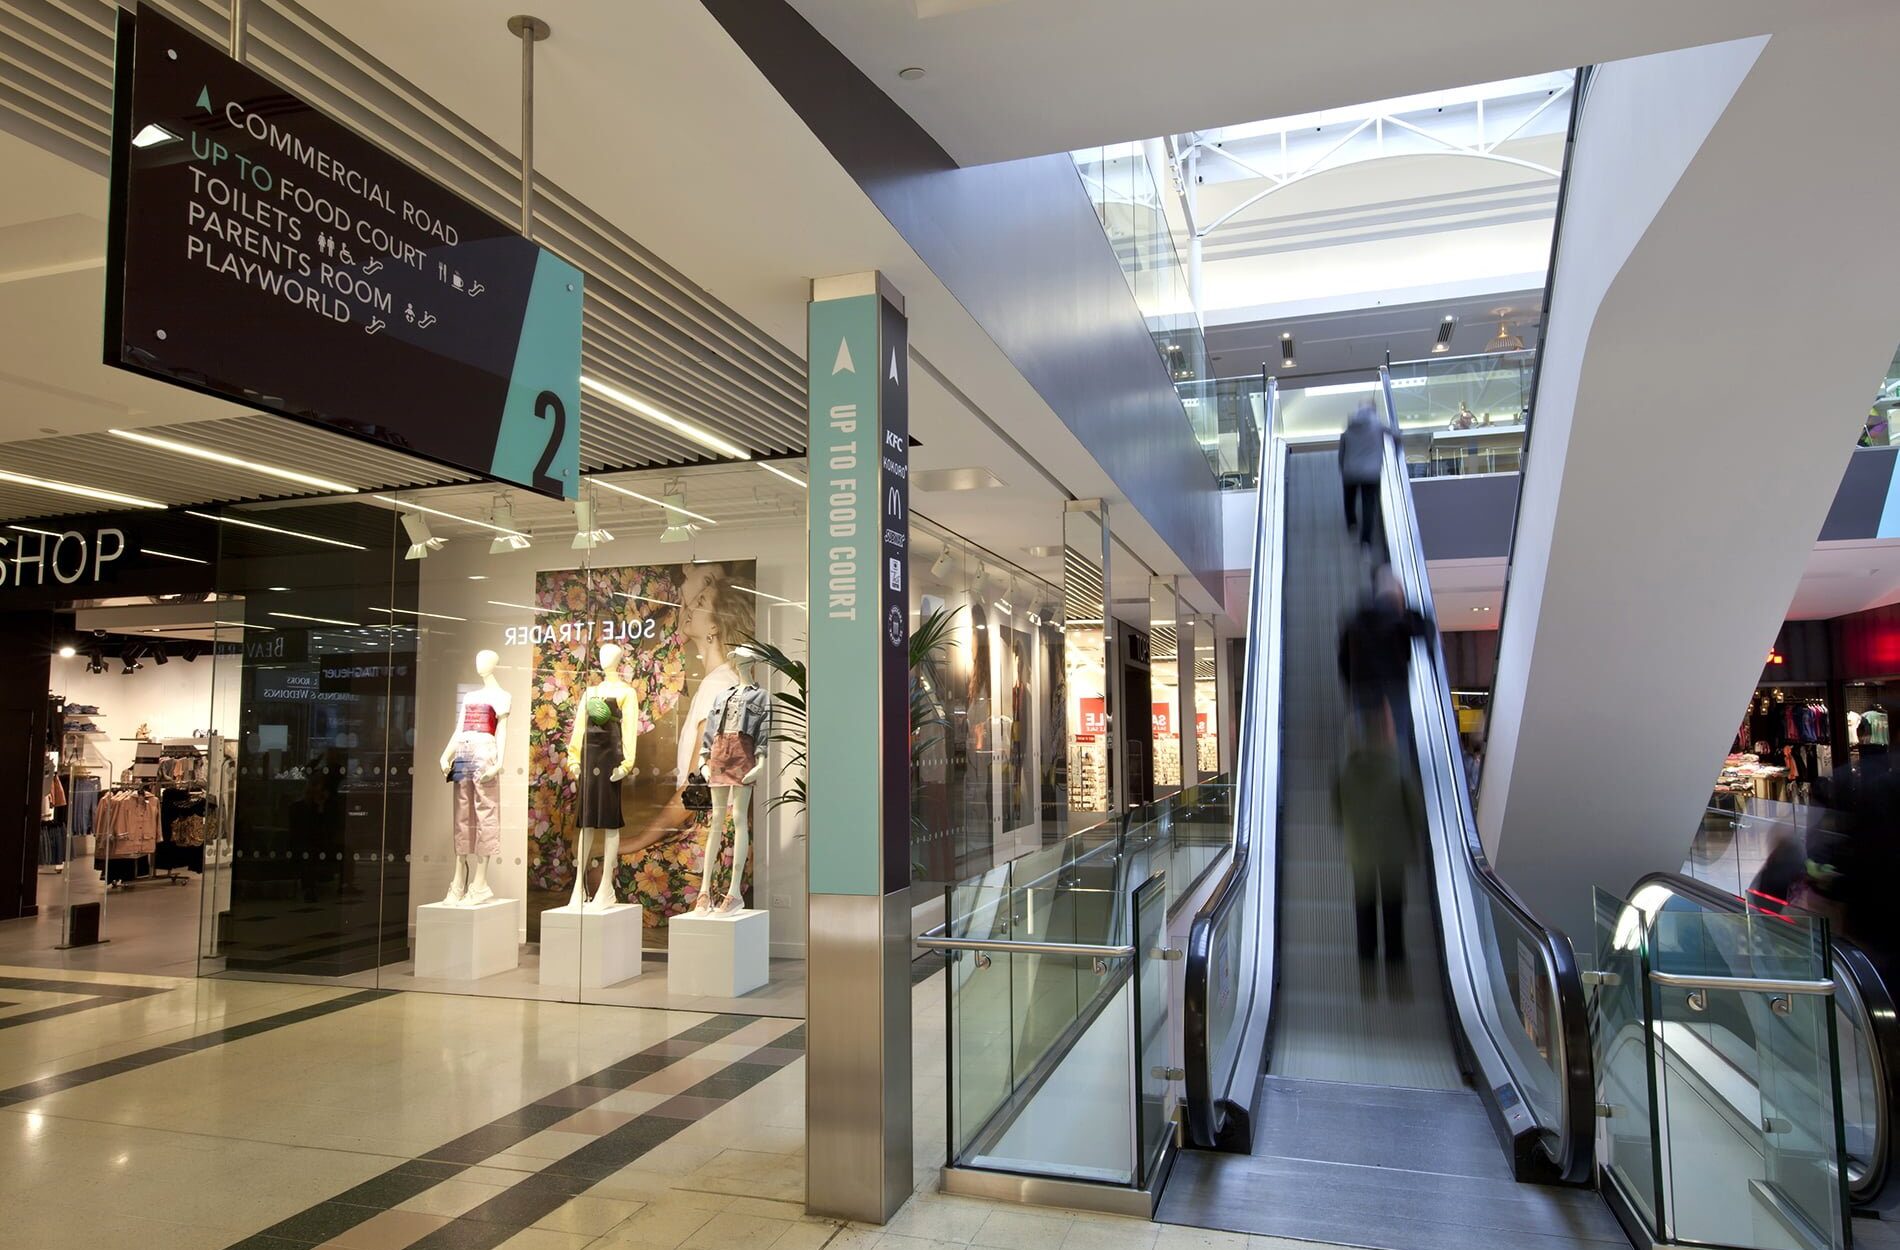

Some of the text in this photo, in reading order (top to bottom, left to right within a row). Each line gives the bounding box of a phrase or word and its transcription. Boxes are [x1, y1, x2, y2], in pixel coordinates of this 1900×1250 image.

[188, 165, 301, 241] TOILETS
[191, 131, 427, 271] UP TO FOOD COURT
[225, 101, 459, 247] COMMERCIAL ROAD
[187, 234, 350, 323] PLAYWORLD
[188, 200, 392, 314] PARENTS ROOM
[532, 390, 566, 498] 2
[885, 429, 903, 453] KFC
[829, 404, 857, 621] UP TO FOOD COURT
